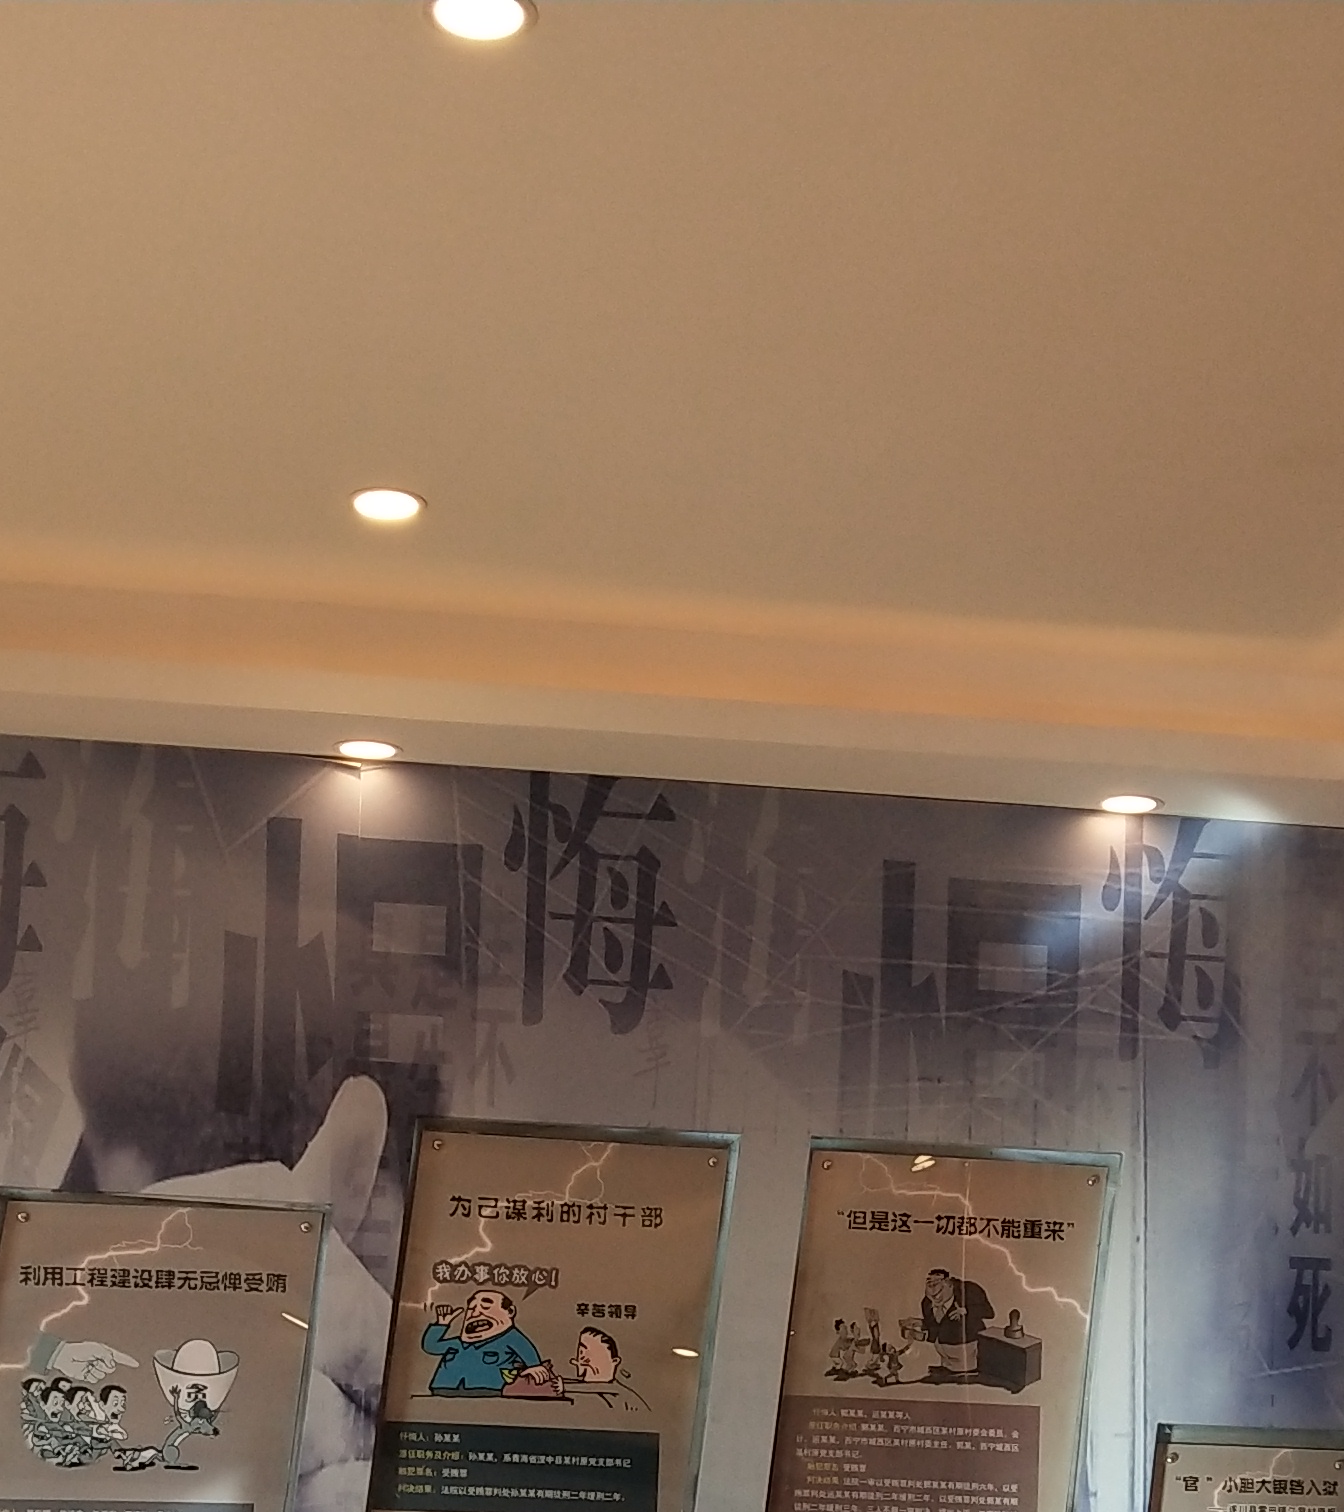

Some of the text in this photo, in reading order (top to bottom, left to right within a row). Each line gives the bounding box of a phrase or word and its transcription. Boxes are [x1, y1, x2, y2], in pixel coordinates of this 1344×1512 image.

[449, 1196, 664, 1229] 为己谋利的村干部
[837, 1210, 1075, 1242] “但是这一切都不能重来”
[19, 1264, 288, 1295] 利用工程建设肆无忌惮受贿
[576, 1303, 637, 1320] 辛苦领导
